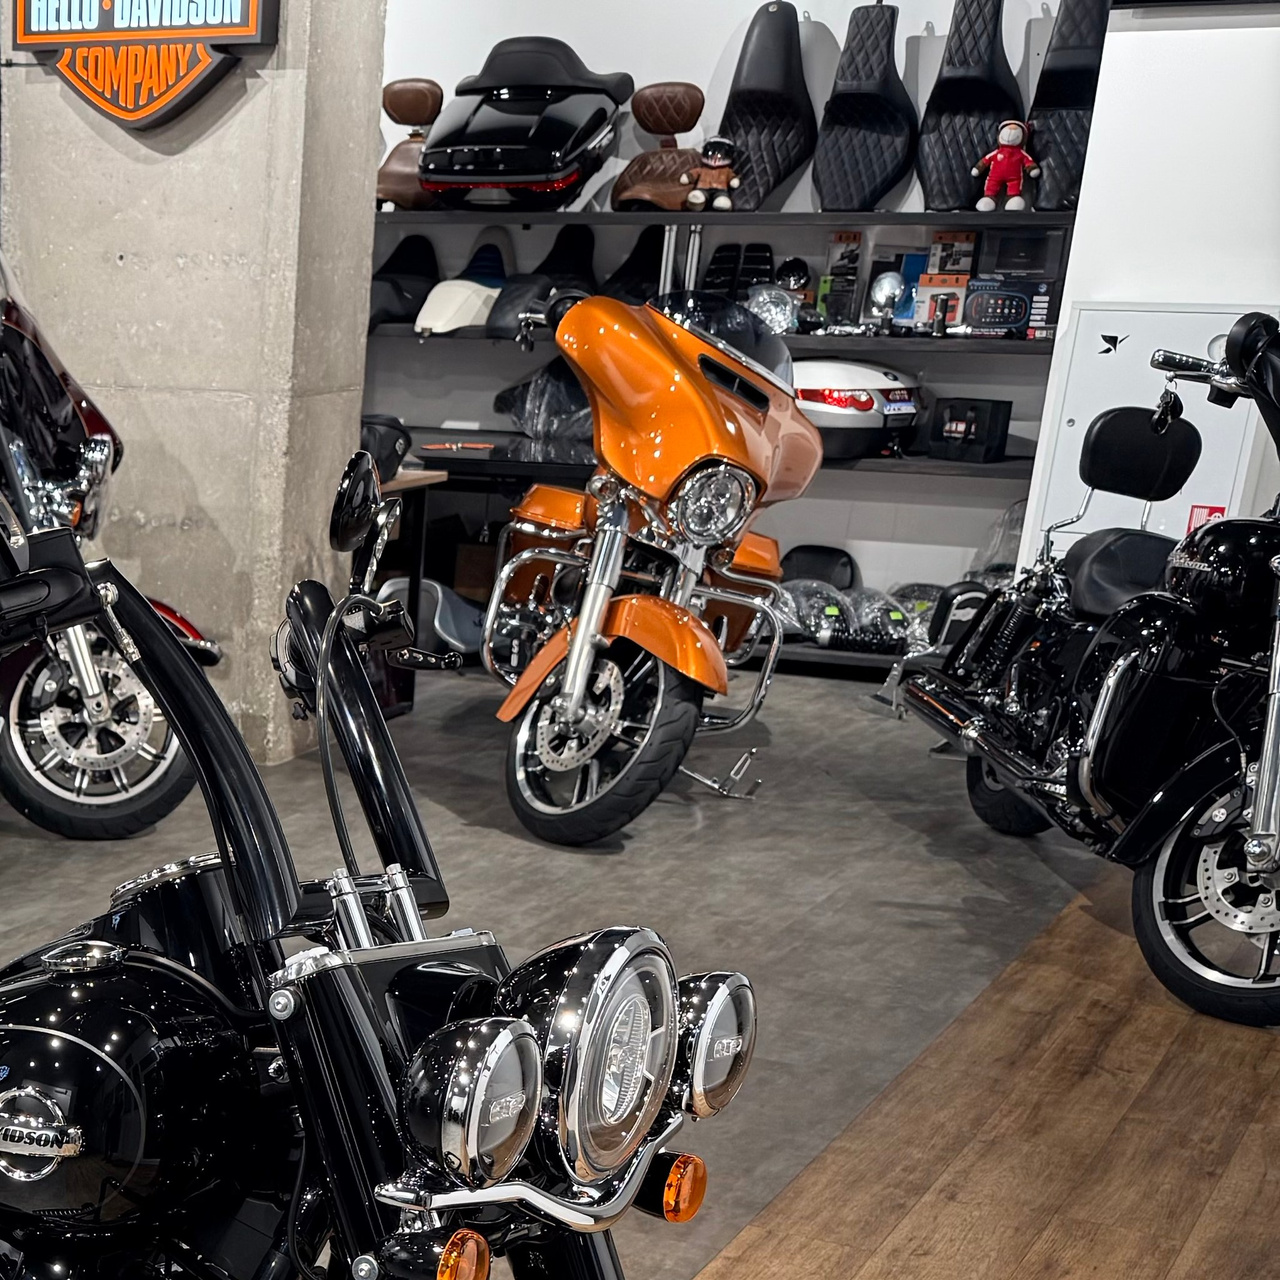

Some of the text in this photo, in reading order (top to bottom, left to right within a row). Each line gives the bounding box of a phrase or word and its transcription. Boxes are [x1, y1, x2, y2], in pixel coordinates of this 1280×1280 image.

[30, 0, 242, 32] HELLO DAVIDSON
[76, 43, 193, 108] COMPANY
